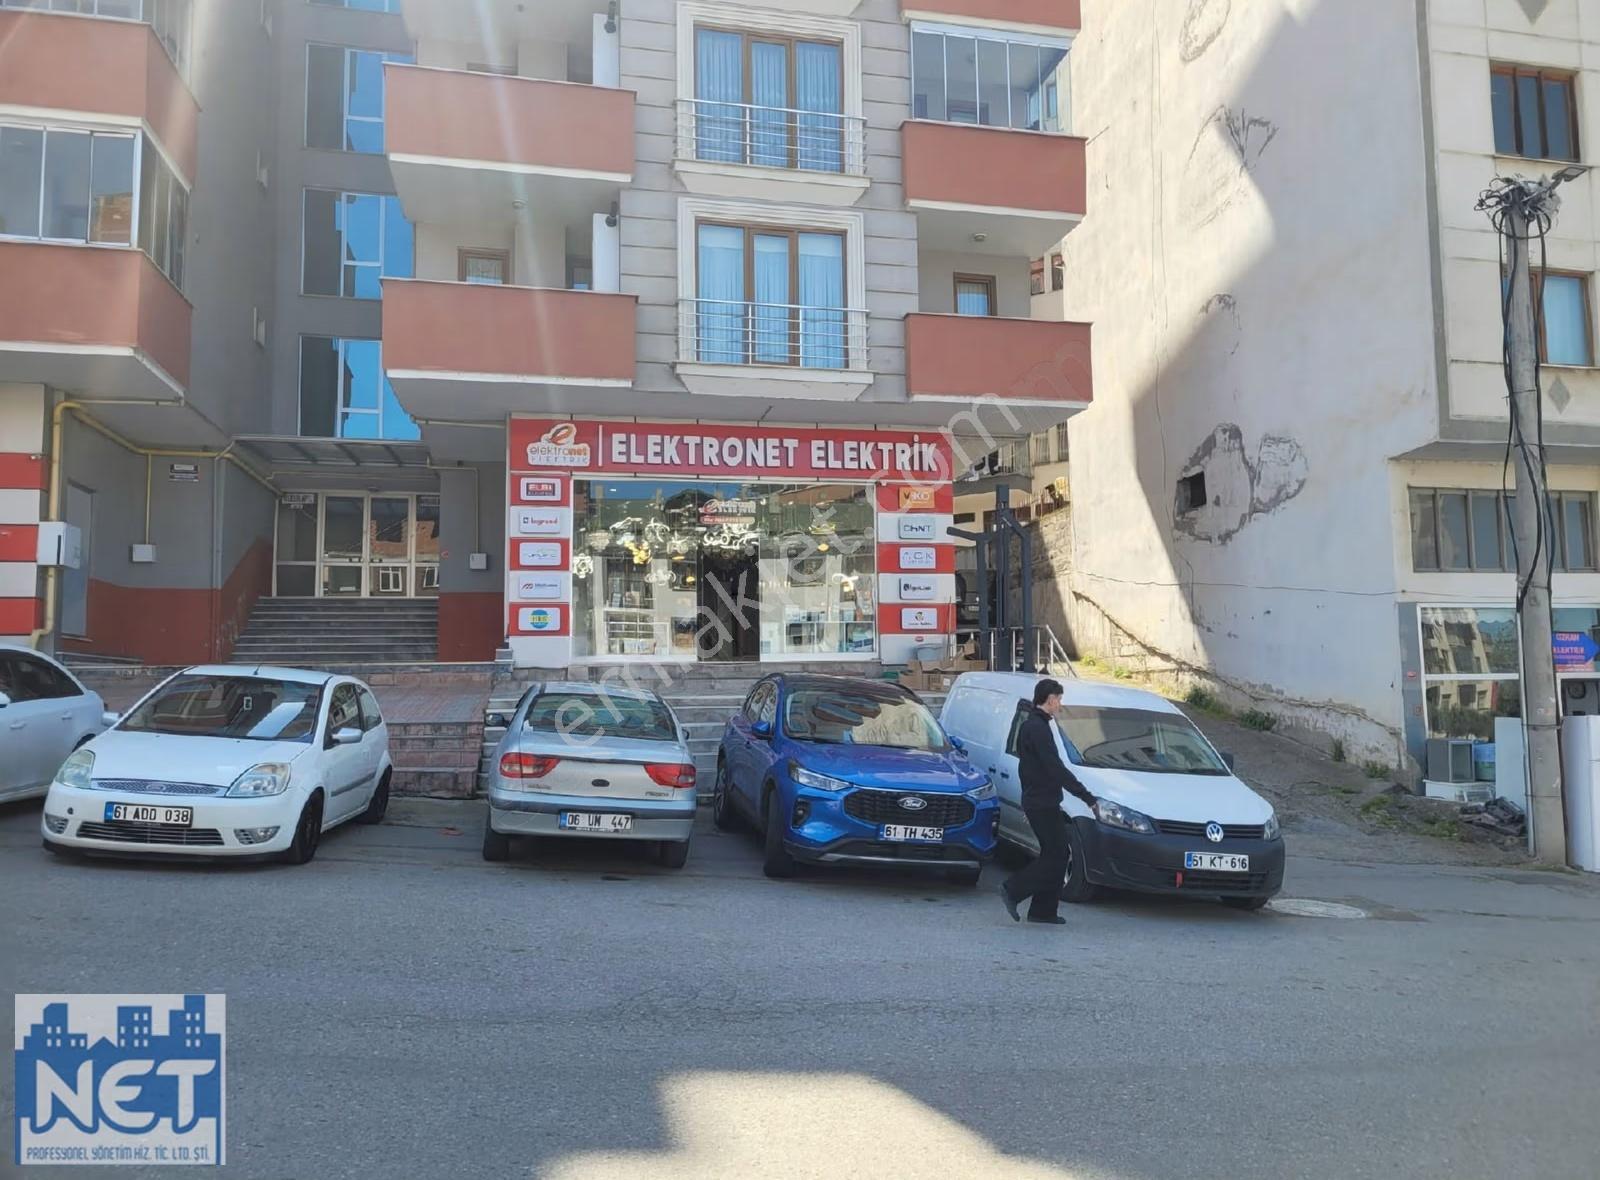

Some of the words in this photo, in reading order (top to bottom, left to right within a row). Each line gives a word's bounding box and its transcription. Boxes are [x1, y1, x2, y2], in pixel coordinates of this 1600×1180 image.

[611, 432, 798, 467] ELEKTRONET
[811, 434, 937, 472] ELEKTRİK
[113, 805, 128, 819] 61
[164, 809, 190, 823] 038
[567, 814, 580, 825] 06
[611, 815, 630, 829] 447
[885, 826, 897, 837] 61
[903, 827, 917, 838] TH
[920, 828, 943, 839] 435
[1209, 856, 1224, 867] KT
[1230, 857, 1248, 869] 616
